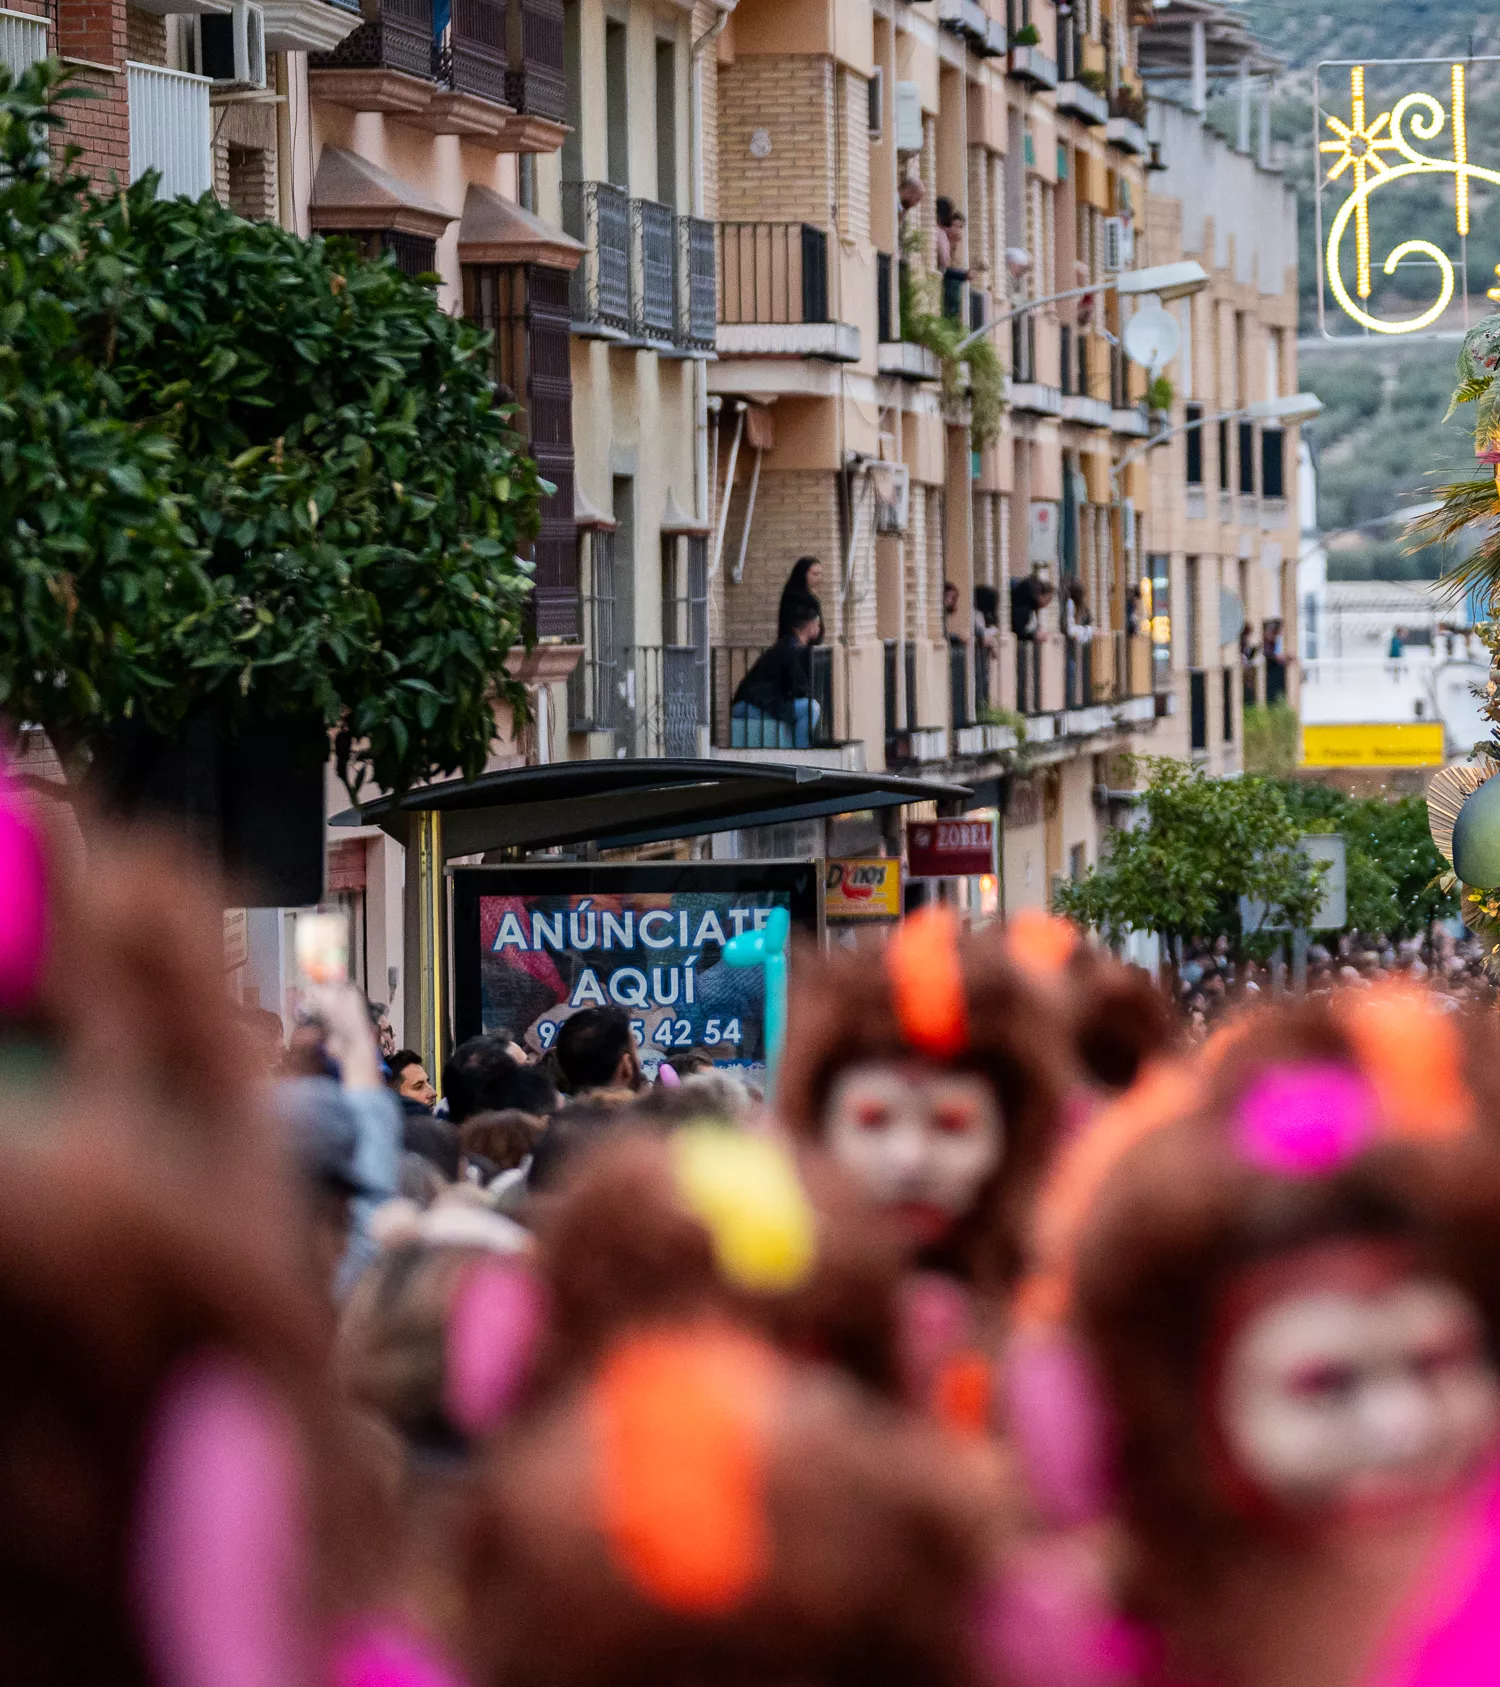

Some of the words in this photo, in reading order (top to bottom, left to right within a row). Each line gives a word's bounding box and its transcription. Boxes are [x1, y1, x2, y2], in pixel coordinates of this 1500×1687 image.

[936, 823, 990, 848] ZOBEL
[570, 955, 698, 1008] AQUÍ
[653, 1018, 692, 1045] 42
[703, 1018, 742, 1045] 54
